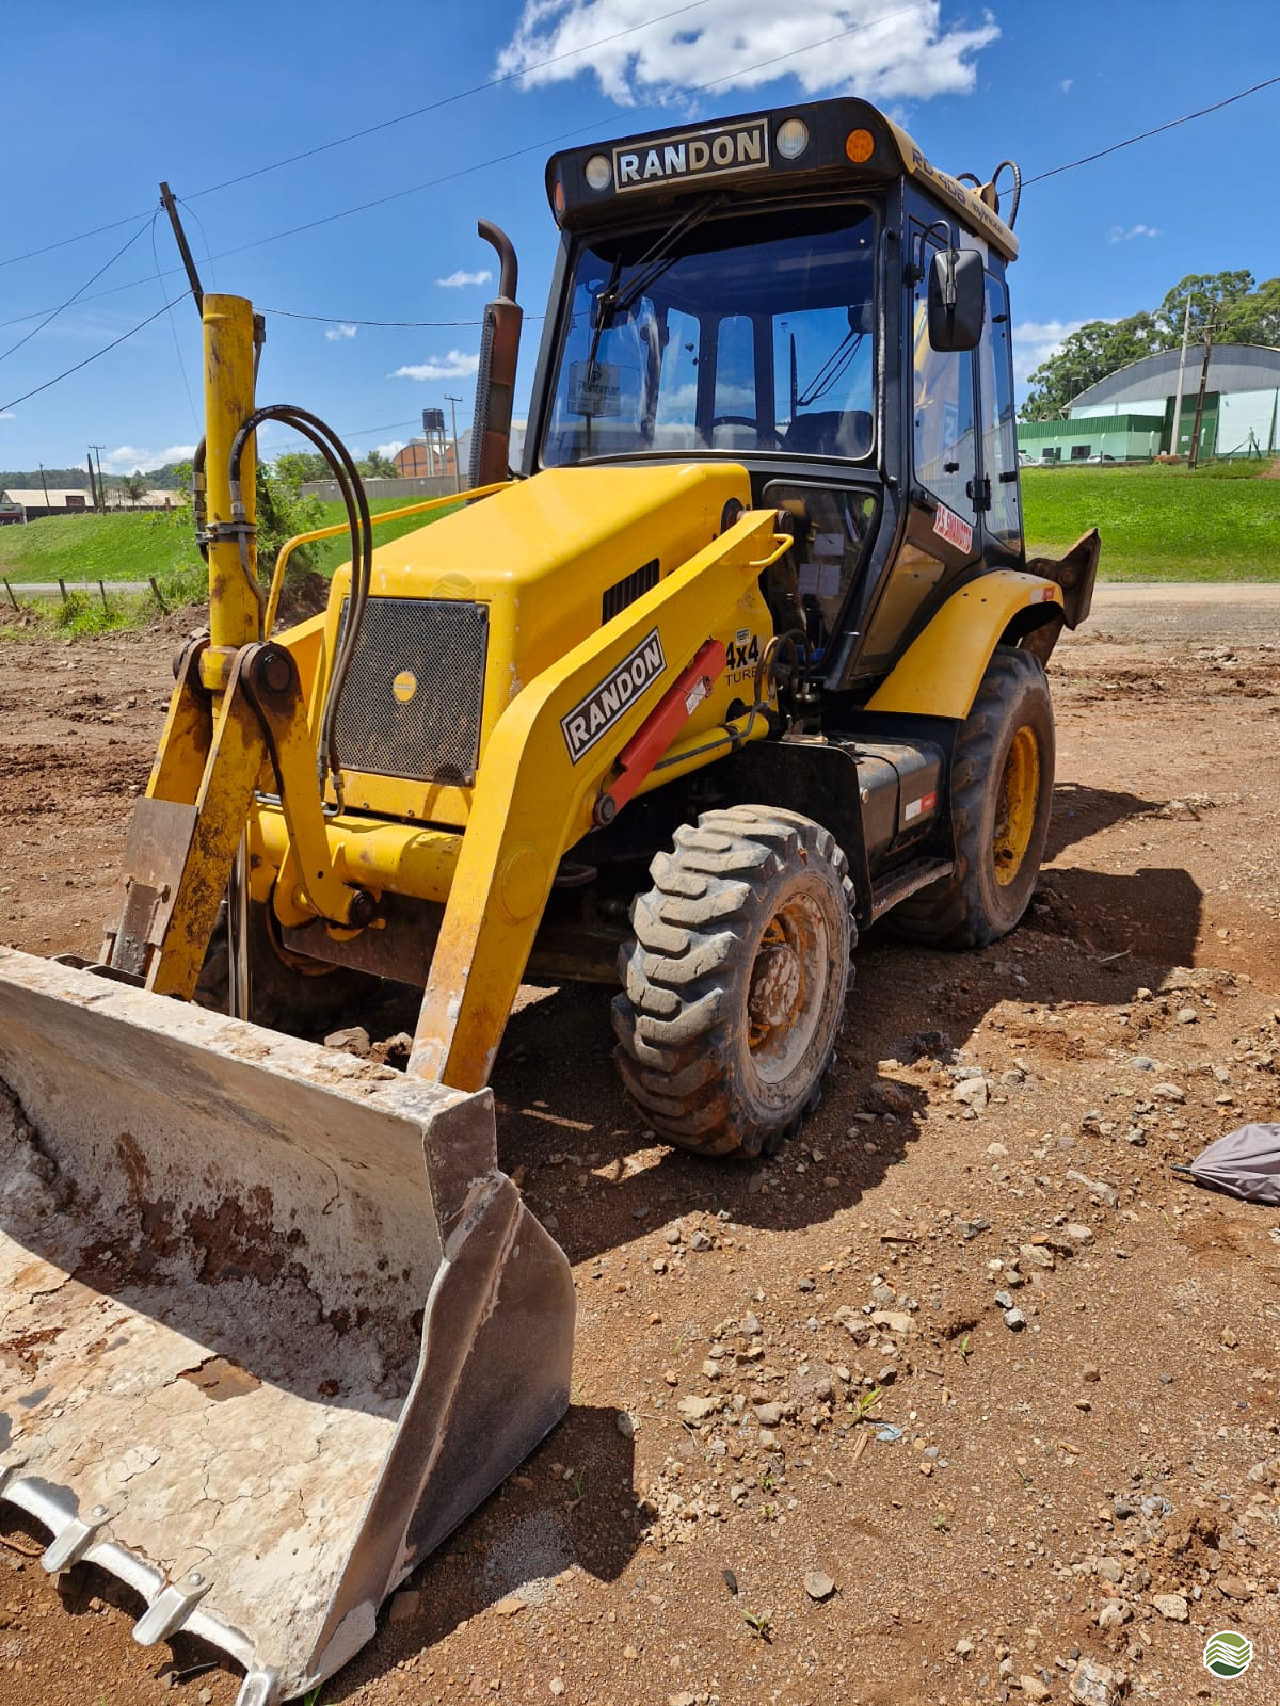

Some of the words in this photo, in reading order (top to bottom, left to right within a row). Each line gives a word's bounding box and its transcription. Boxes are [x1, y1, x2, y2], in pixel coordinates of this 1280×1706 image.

[620, 130, 761, 182] RANDON
[911, 146, 933, 176] RD
[725, 635, 759, 670] 4x4
[569, 640, 661, 750] RANDON
